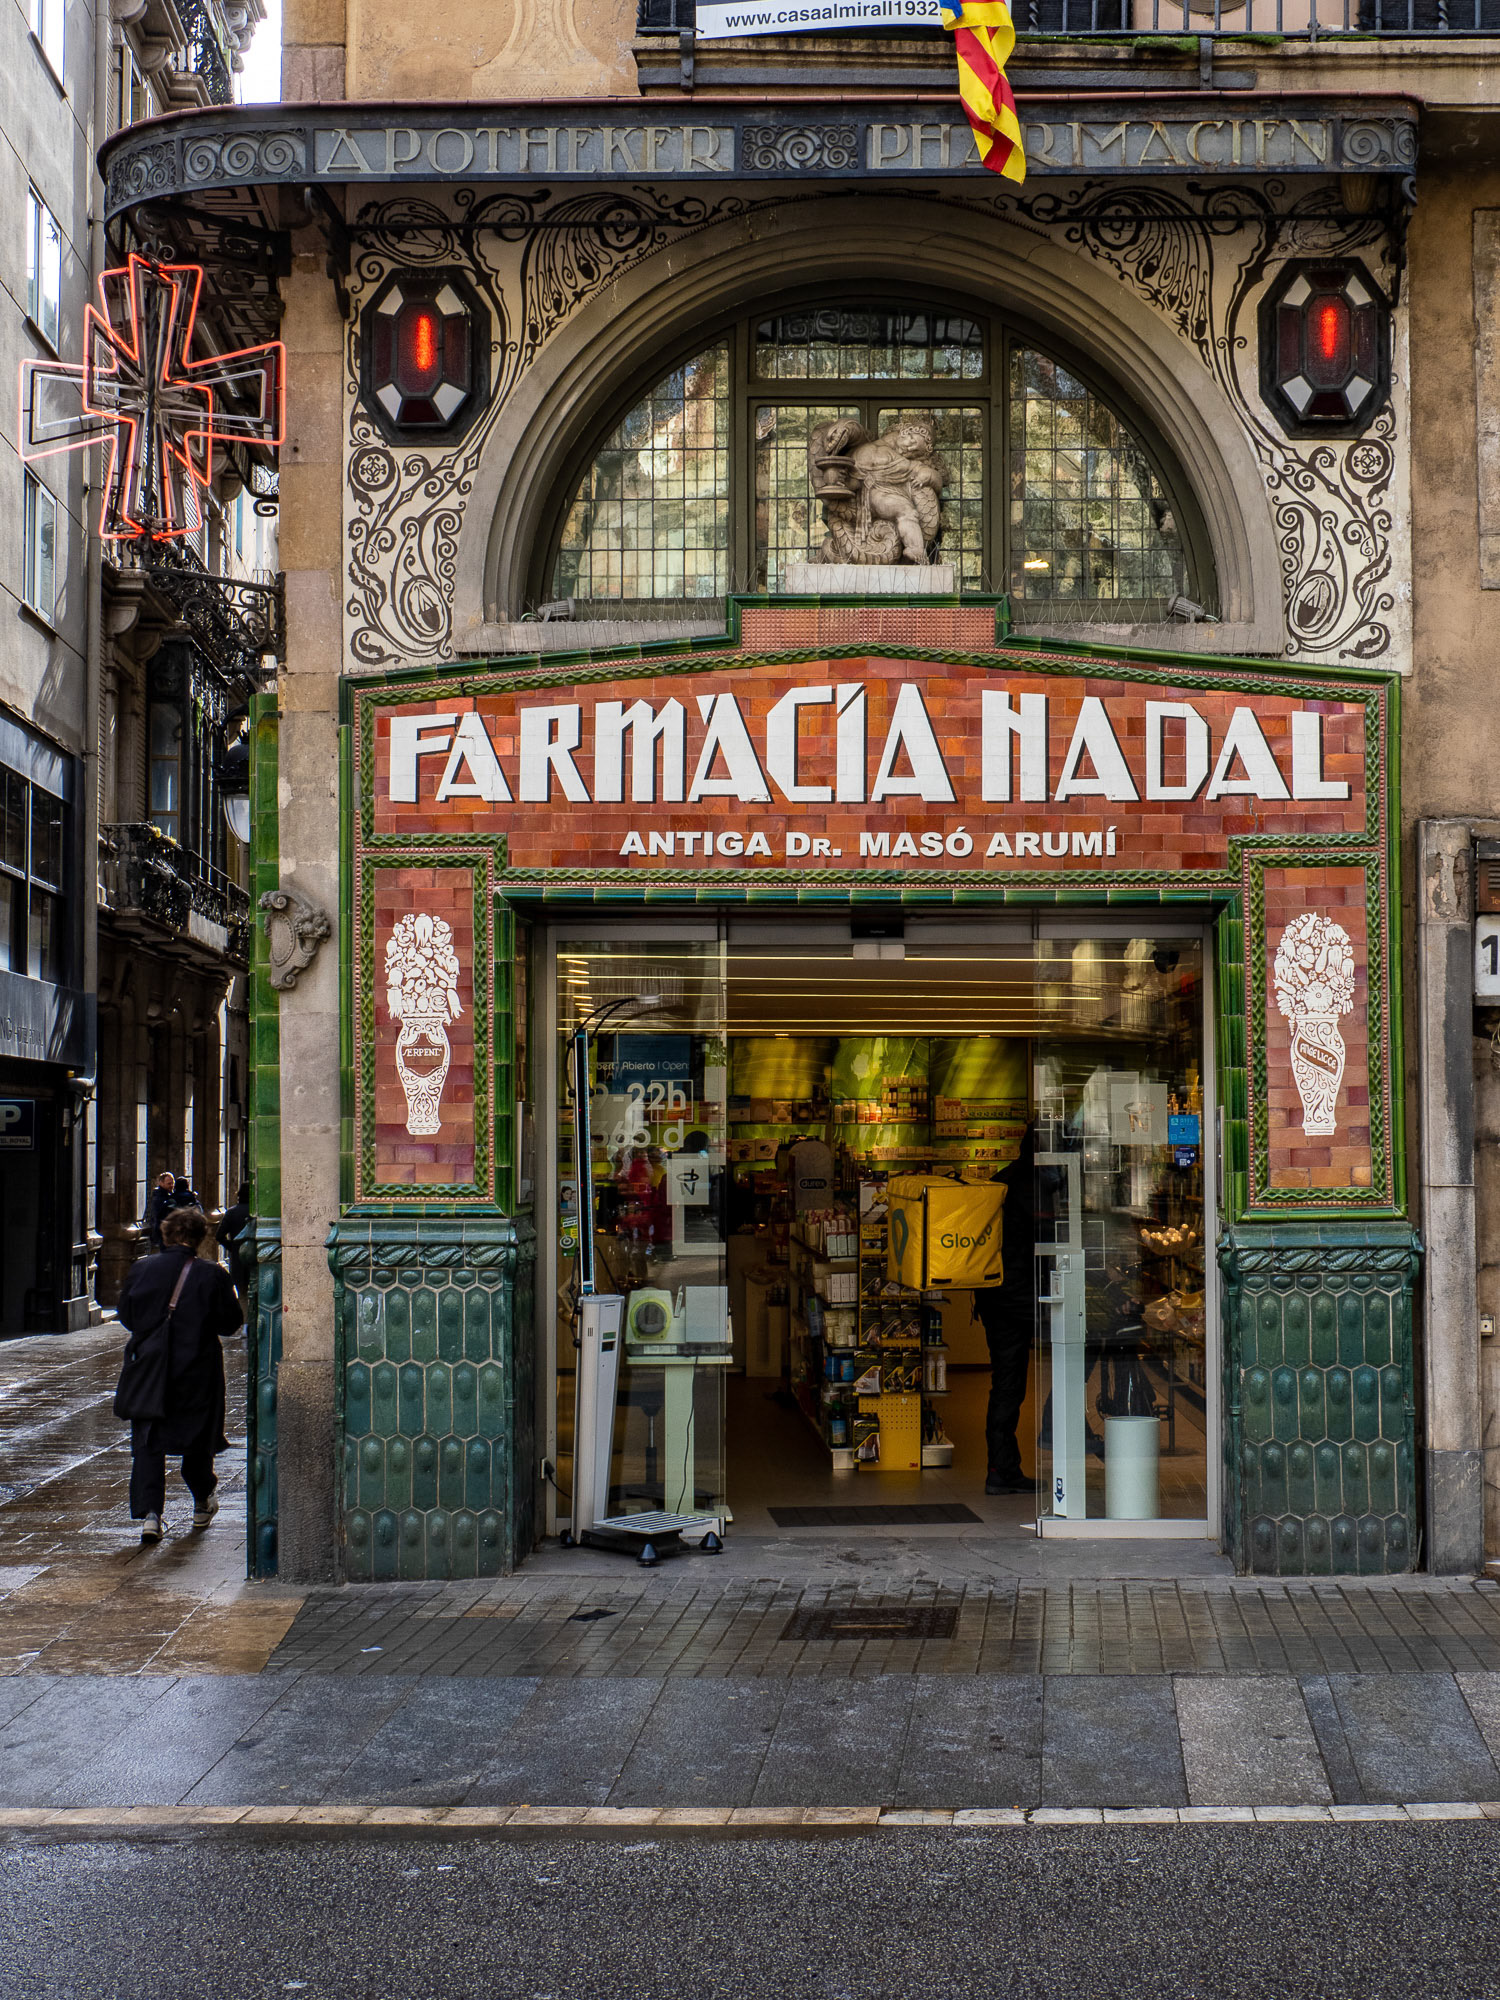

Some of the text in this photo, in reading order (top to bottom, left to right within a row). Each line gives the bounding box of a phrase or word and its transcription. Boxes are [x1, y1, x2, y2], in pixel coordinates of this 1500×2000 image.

[318, 119, 1332, 174] APOTHEKER PHRMACIEN
[981, 689, 1351, 803] NADAL
[619, 831, 772, 857] ANTIGA
[859, 826, 974, 857] MASÓ
[985, 825, 1118, 857] ARUMÍ
[1480, 934, 1499, 976] 1
[622, 1060, 656, 1071] Abierto
[662, 1060, 688, 1072] Open
[0, 1104, 22, 1132] P
[941, 1231, 988, 1248] Glovo
